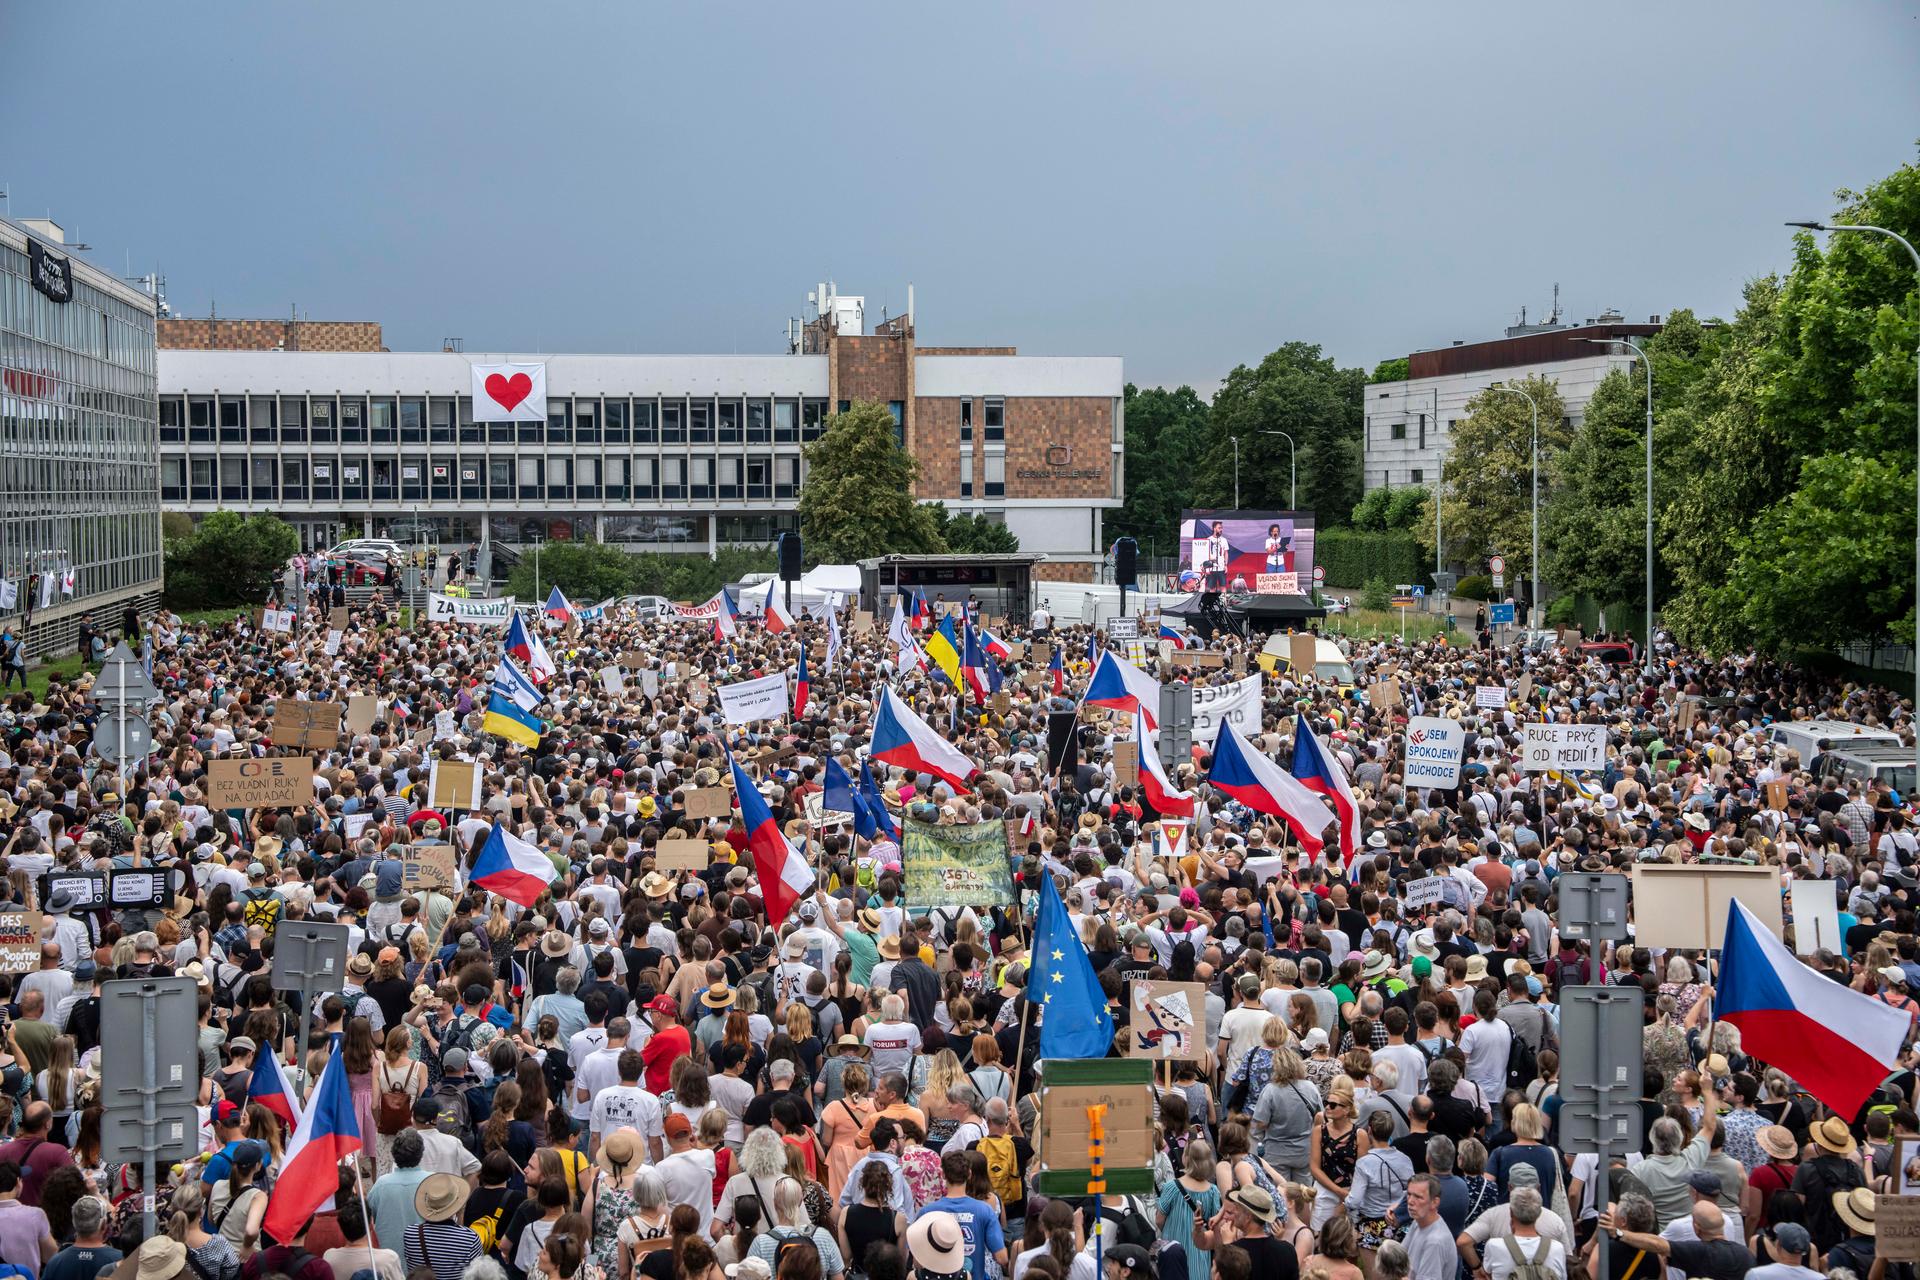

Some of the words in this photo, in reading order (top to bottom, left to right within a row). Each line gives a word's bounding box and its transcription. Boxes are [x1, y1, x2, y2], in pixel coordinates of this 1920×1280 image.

[437, 601, 455, 614] ZA
[660, 604, 675, 616] ZA
[1528, 729, 1558, 742] RUCE
[1567, 728, 1596, 743] PRYČ
[1409, 746, 1458, 759] SPOKOJENÝ
[1533, 749, 1549, 761] OD
[1558, 745, 1590, 762] MEDIÍ
[217, 781, 233, 790] BEZ
[275, 777, 299, 788] RUKY
[225, 794, 241, 802] NA
[406, 848, 421, 860] NE
[1, 914, 23, 927] PES
